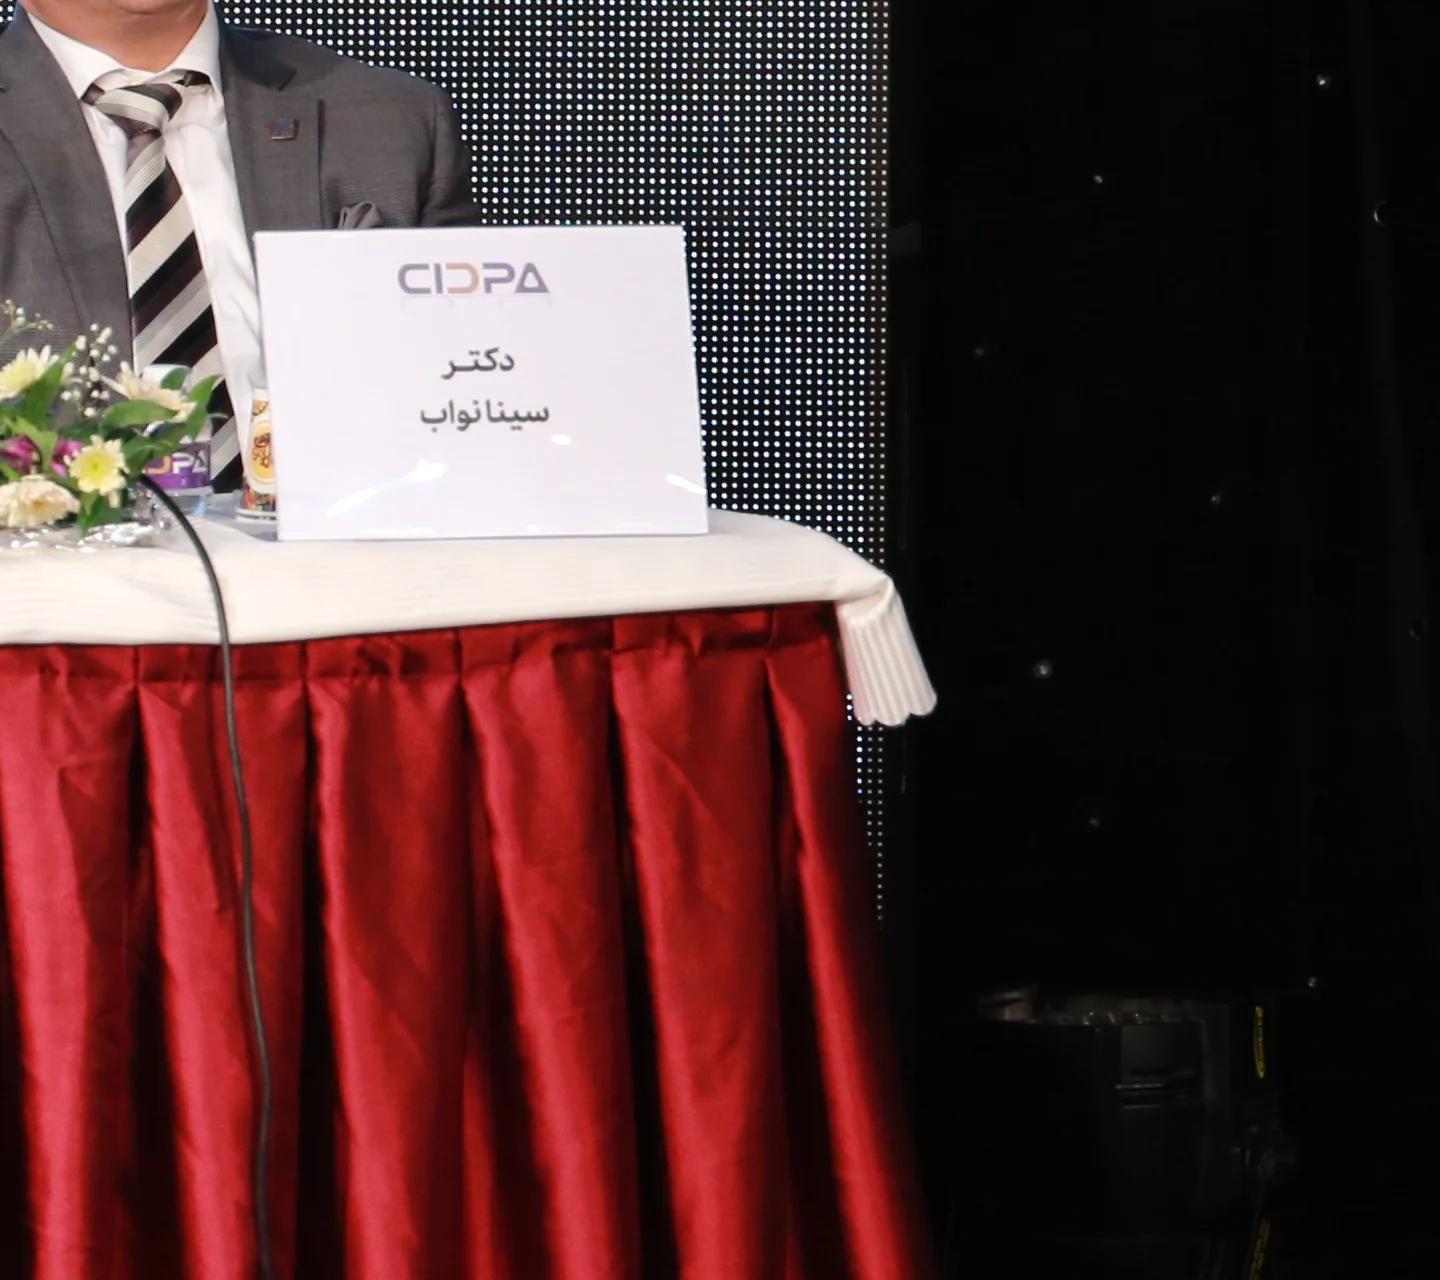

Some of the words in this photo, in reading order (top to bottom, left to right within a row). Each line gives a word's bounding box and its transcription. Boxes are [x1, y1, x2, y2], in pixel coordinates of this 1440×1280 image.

[397, 262, 550, 295] CIDPA
[441, 346, 515, 380] دکتر
[420, 398, 482, 432] نواب
[486, 398, 550, 432] سینا
